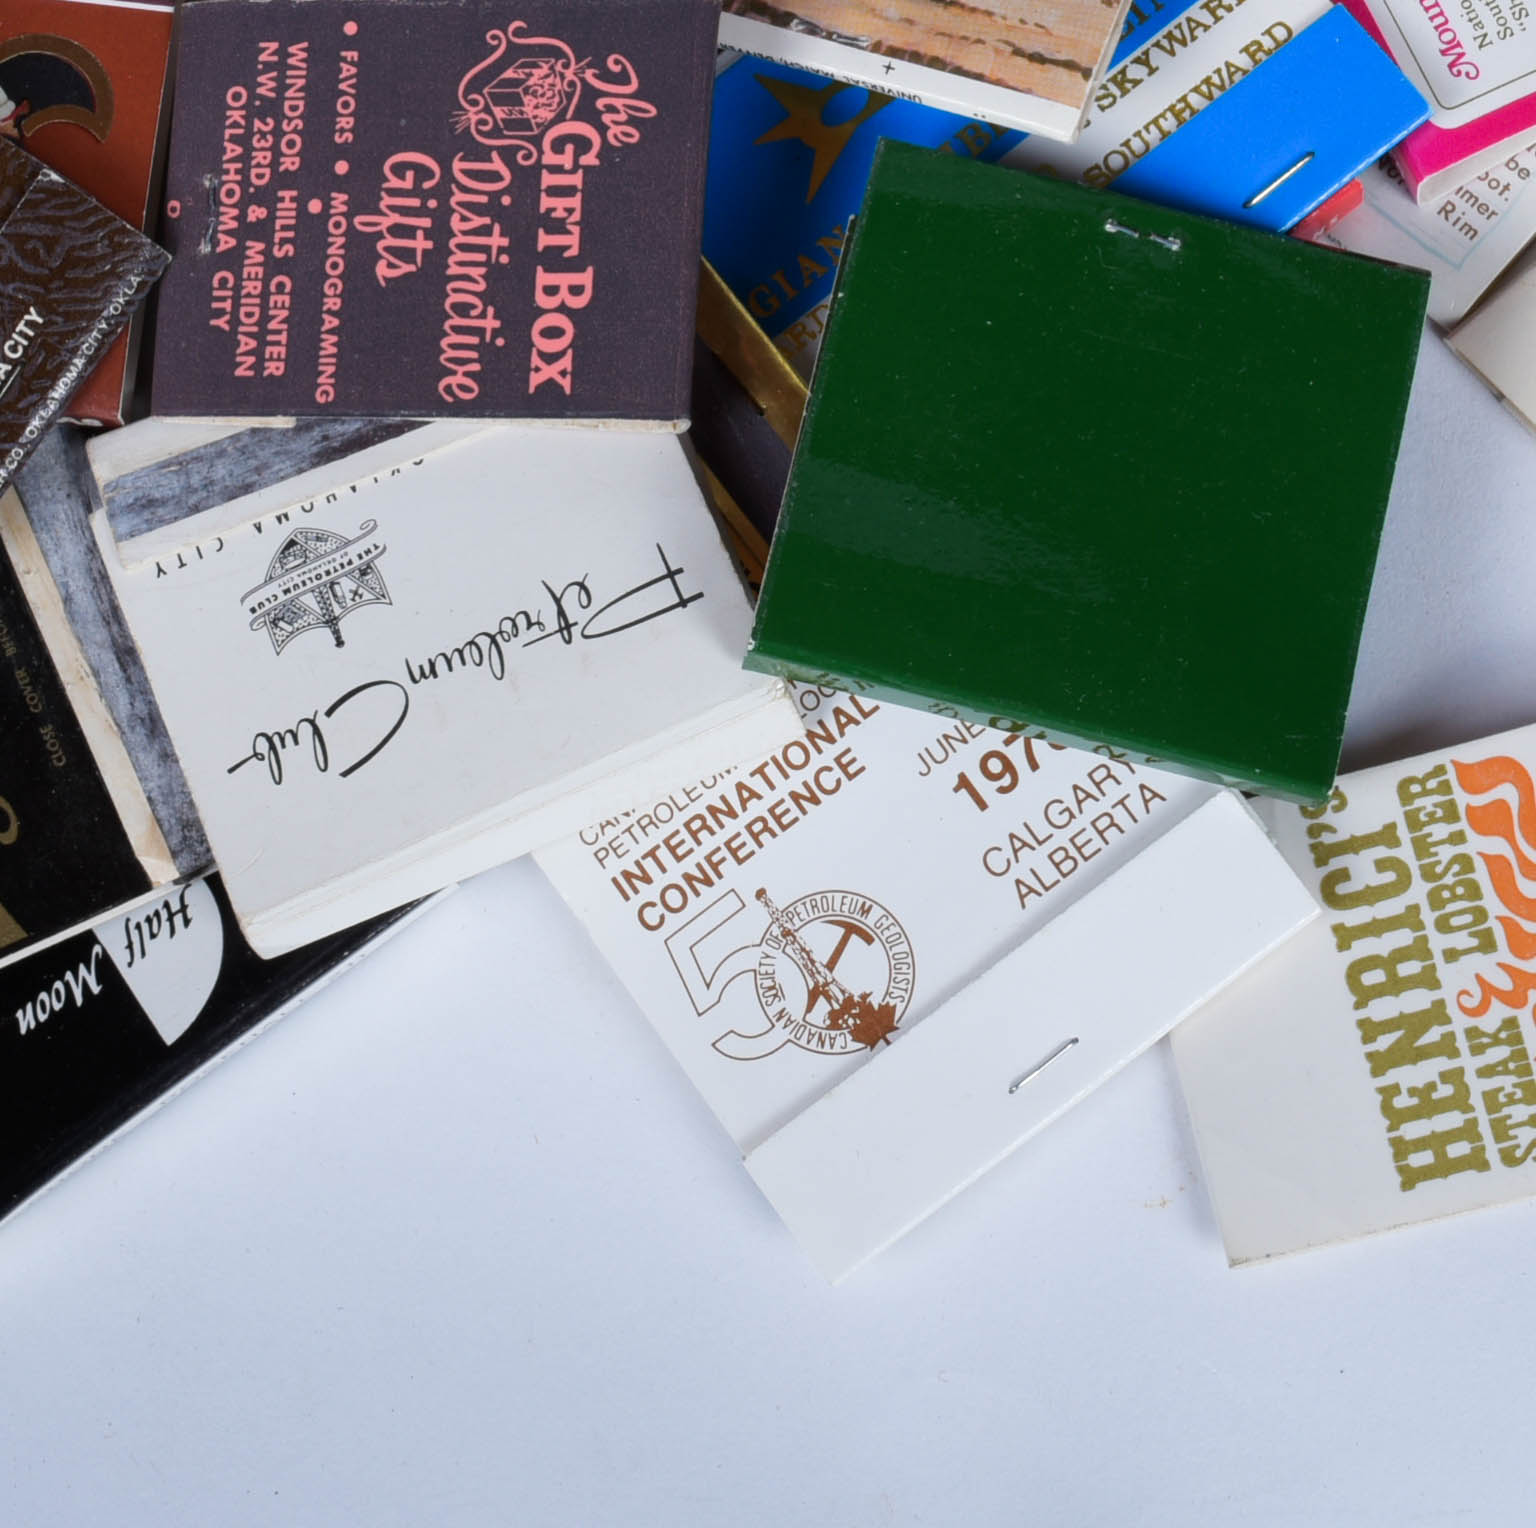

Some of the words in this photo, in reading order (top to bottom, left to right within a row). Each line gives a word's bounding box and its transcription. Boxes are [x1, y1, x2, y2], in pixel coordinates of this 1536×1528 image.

[279, 41, 309, 173] WINDSOR
[334, 49, 359, 145] FAVORS
[583, 54, 658, 147] The
[1082, 20, 1294, 189] SOUTHWARD
[273, 189, 298, 259] HILLS
[353, 150, 441, 287] Gifts
[535, 121, 602, 257] GIFT
[1437, 201, 1479, 241] Rim
[208, 269, 235, 333] CITY
[234, 239, 265, 378] MERIDIAN
[263, 274, 294, 378] CENTER
[437, 151, 512, 404] Distinctive
[528, 266, 595, 395] BOX
[3, 306, 45, 359] CITY
[249, 593, 281, 616] CLUB
[405, 543, 705, 684] Petroleum
[40, 724, 66, 768] CLOSE
[227, 679, 410, 787] Club
[611, 695, 880, 902] INTERNATIONAL
[637, 747, 866, 931] CONFERENCE
[983, 756, 1136, 877] CALGARY
[1014, 783, 1167, 910] ALBERTA
[1396, 763, 1499, 965] LOBSTER
[122, 881, 196, 966] Half
[873, 914, 911, 1003] GEOLOGISTS
[14, 942, 107, 1038] Moon
[759, 951, 782, 1007] SOCIETY
[773, 1008, 847, 1049] CANADIAN
[1298, 783, 1491, 1193] HENRICI'S
